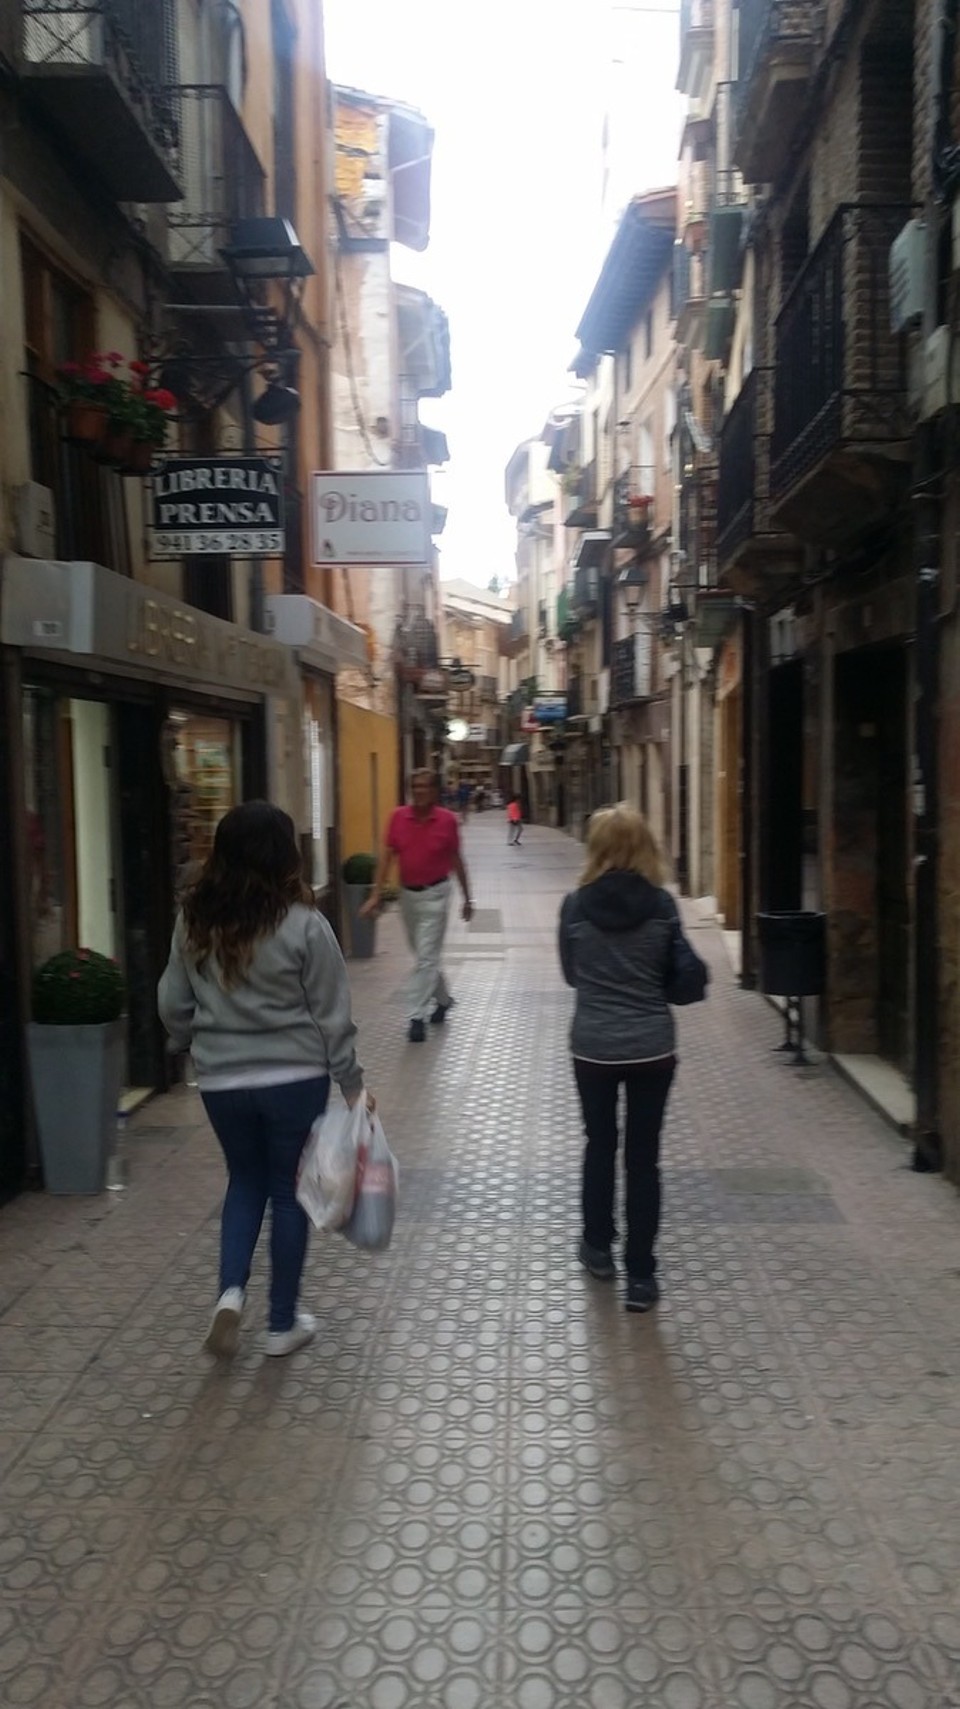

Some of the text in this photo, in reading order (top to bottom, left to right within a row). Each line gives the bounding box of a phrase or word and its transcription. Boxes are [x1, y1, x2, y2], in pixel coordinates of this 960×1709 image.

[154, 466, 278, 497] LIBRERIA
[160, 502, 276, 524] PRENSA
[319, 490, 421, 523] Diana
[156, 534, 192, 551] 941
[196, 534, 224, 550] 36
[256, 534, 281, 550] 35
